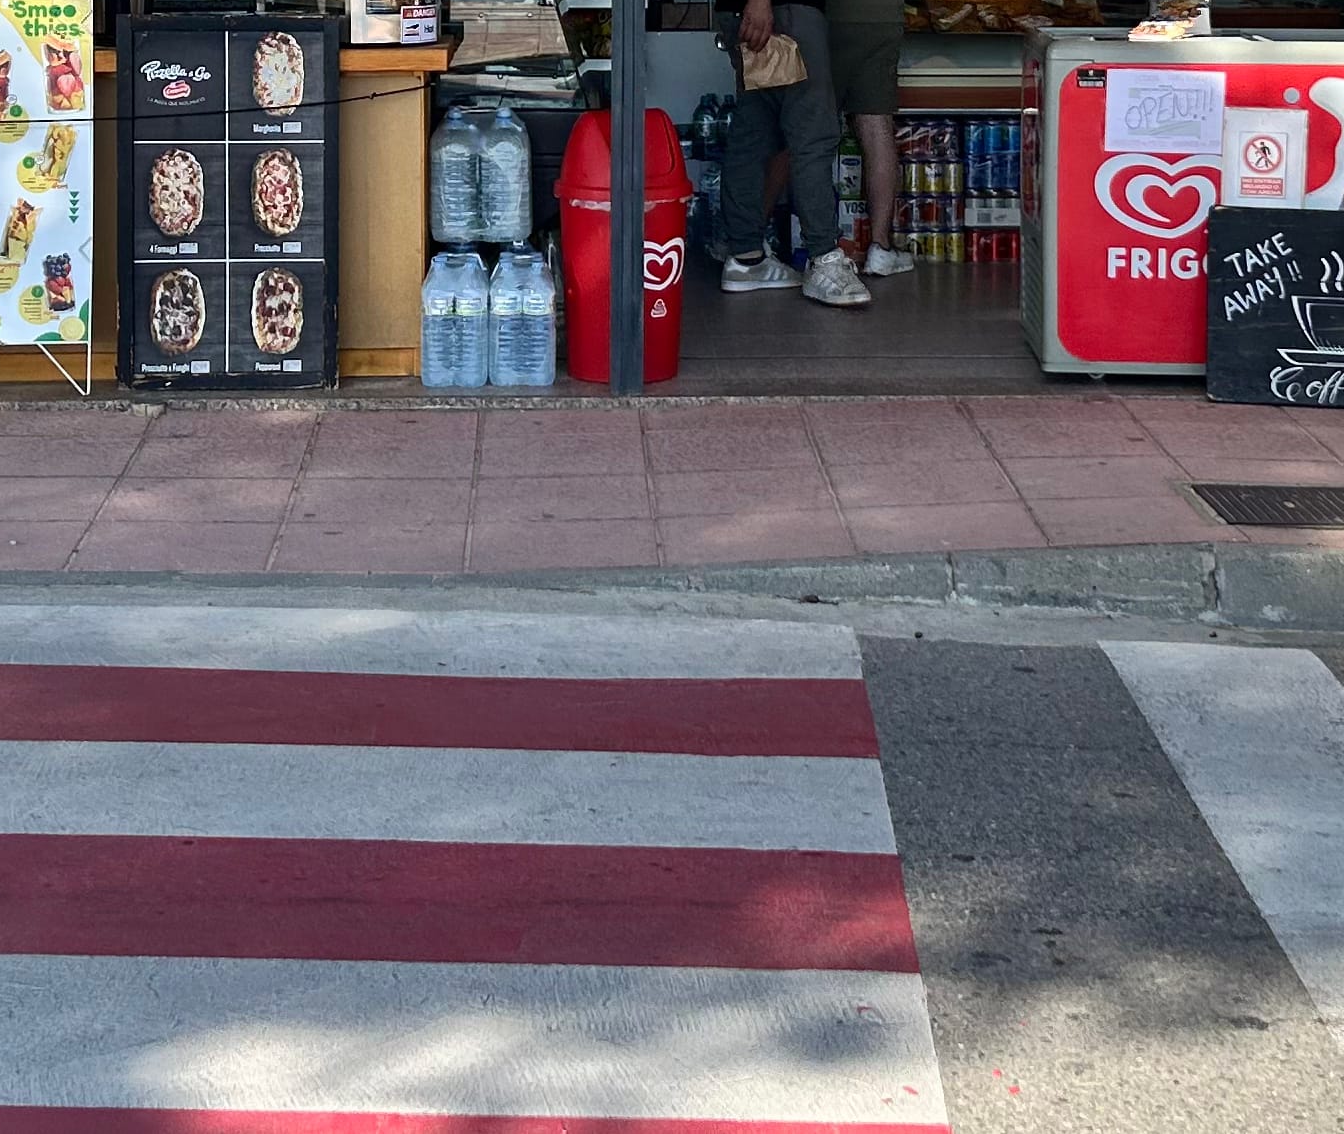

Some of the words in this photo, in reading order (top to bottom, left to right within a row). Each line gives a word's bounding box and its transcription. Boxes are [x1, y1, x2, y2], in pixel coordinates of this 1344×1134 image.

[13, 0, 77, 19] Smoo
[23, 18, 81, 37] thies
[193, 66, 211, 81] Go
[1107, 246, 1209, 280] FRIG
[1223, 232, 1293, 278] TAKE
[1222, 267, 1288, 321] AWAY
